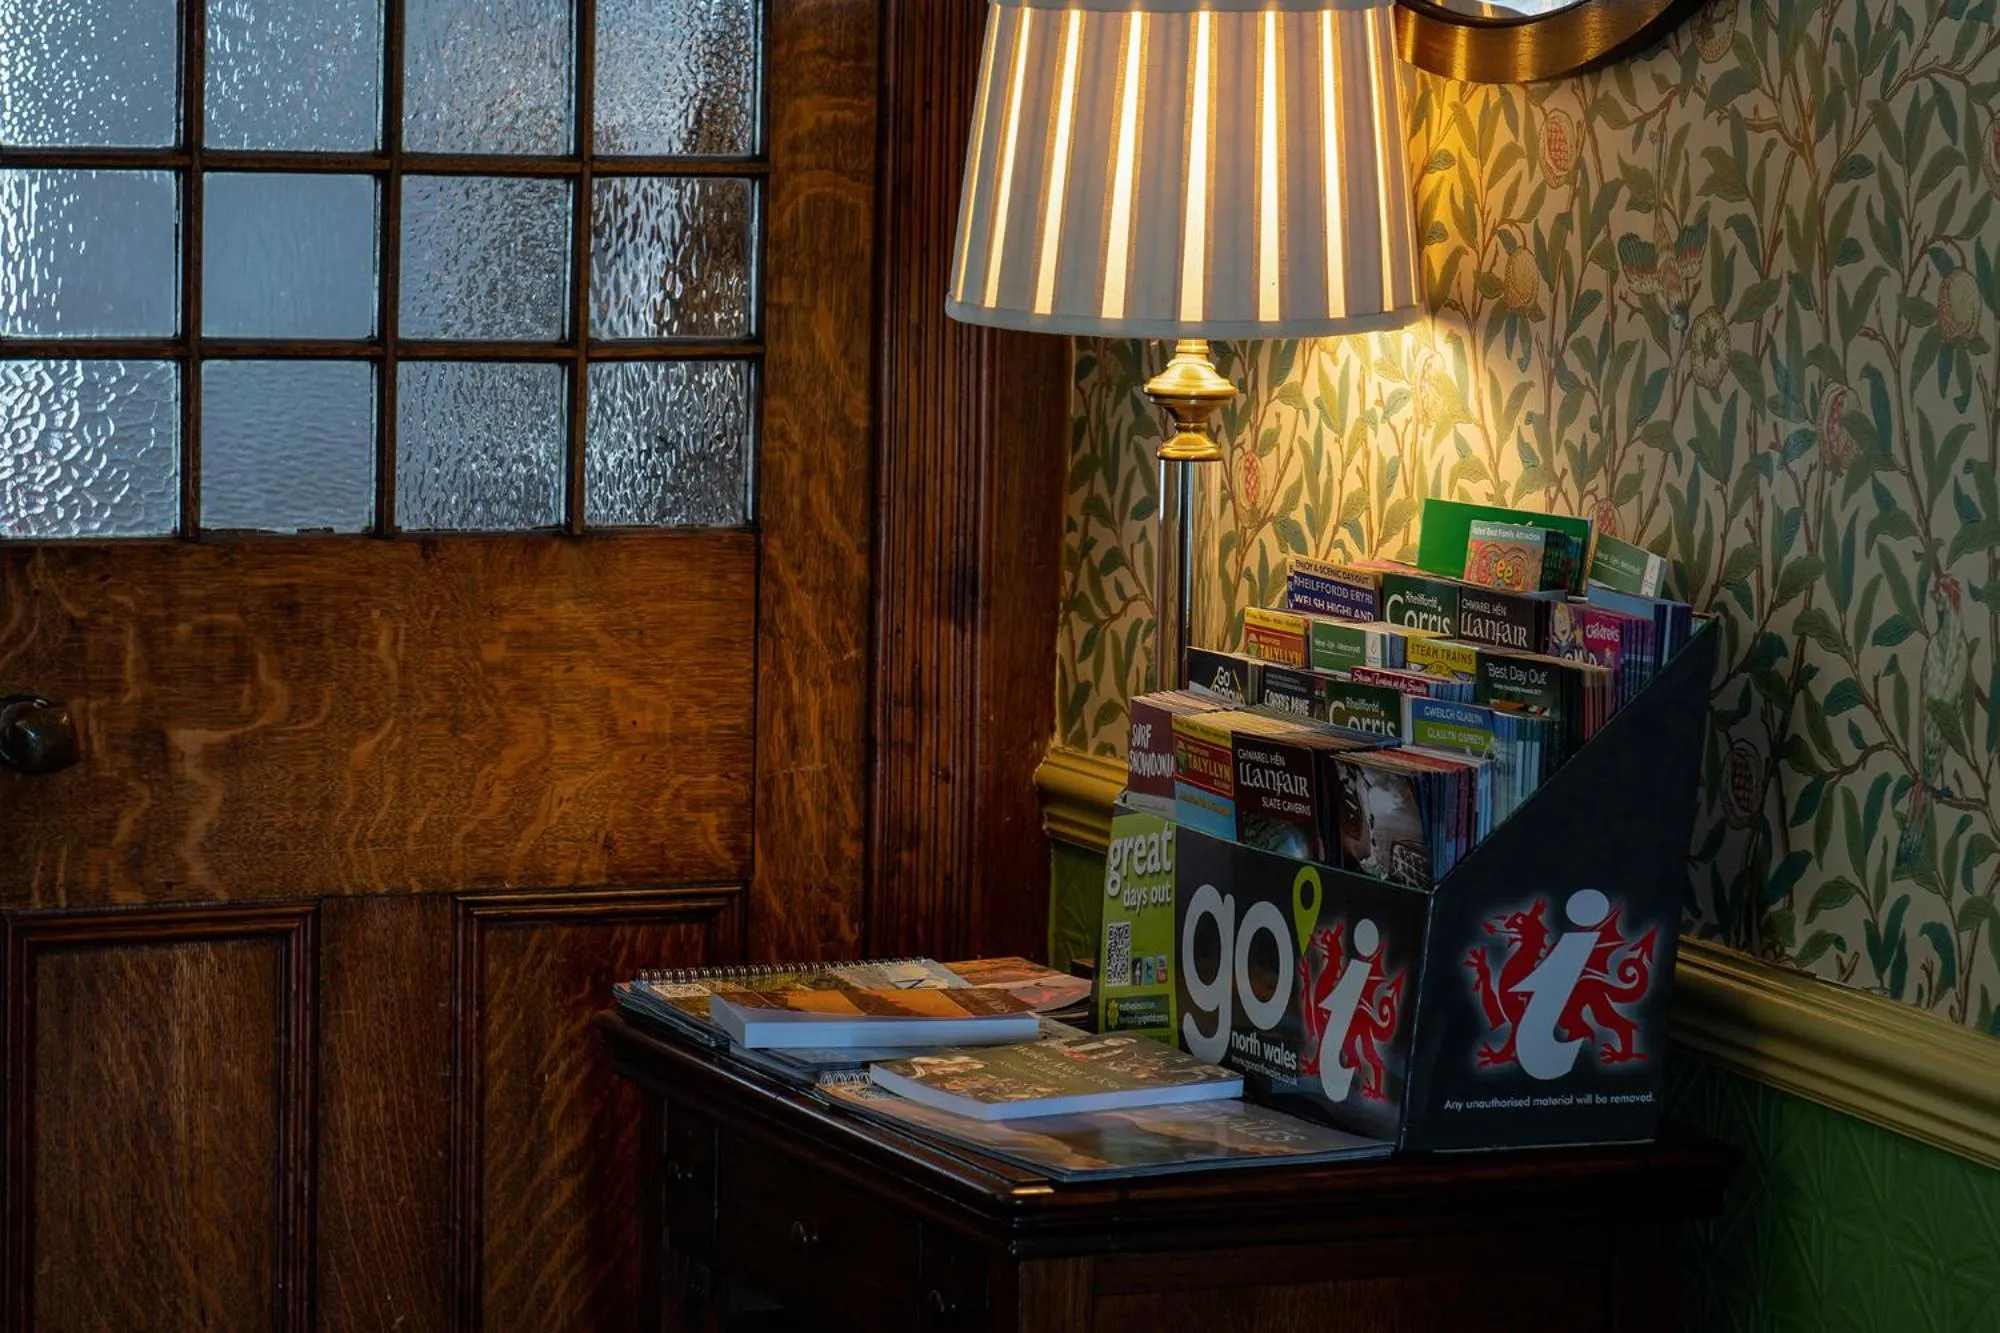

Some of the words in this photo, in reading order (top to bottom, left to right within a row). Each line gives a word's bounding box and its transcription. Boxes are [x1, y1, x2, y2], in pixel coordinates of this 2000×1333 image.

[1320, 566, 1342, 580] SCENIC
[1294, 576, 1348, 598] RHEILFFORDD
[1350, 590, 1373, 606] ERYRI
[1294, 594, 1325, 611] WELSH
[1327, 600, 1374, 622] HIGHLAND
[1386, 594, 1452, 635] Corris
[1411, 643, 1438, 660] STEAM
[1440, 648, 1473, 664] TRAINS
[1510, 665, 1528, 685] Day
[1329, 700, 1396, 737] Corris
[1132, 724, 1152, 749] SURF
[1428, 728, 1456, 742] GLASLYN
[1188, 752, 1232, 782] TALYLLYN
[1261, 796, 1282, 810] SLATE
[1282, 800, 1312, 817] CAVERNS
[1106, 821, 1172, 897] great
[1124, 881, 1148, 913] days
[1151, 881, 1172, 905] out
[1182, 884, 1294, 1065] go
[1232, 1031, 1260, 1058] north
[1263, 1042, 1297, 1070] wales
[1444, 1100, 1464, 1112] Any
[1466, 1096, 1530, 1110] unauthorised
[1533, 1094, 1574, 1106] material
[1576, 1094, 1593, 1104] will
[1595, 1093, 1608, 1104] be
[1610, 1092, 1656, 1104] removed.
